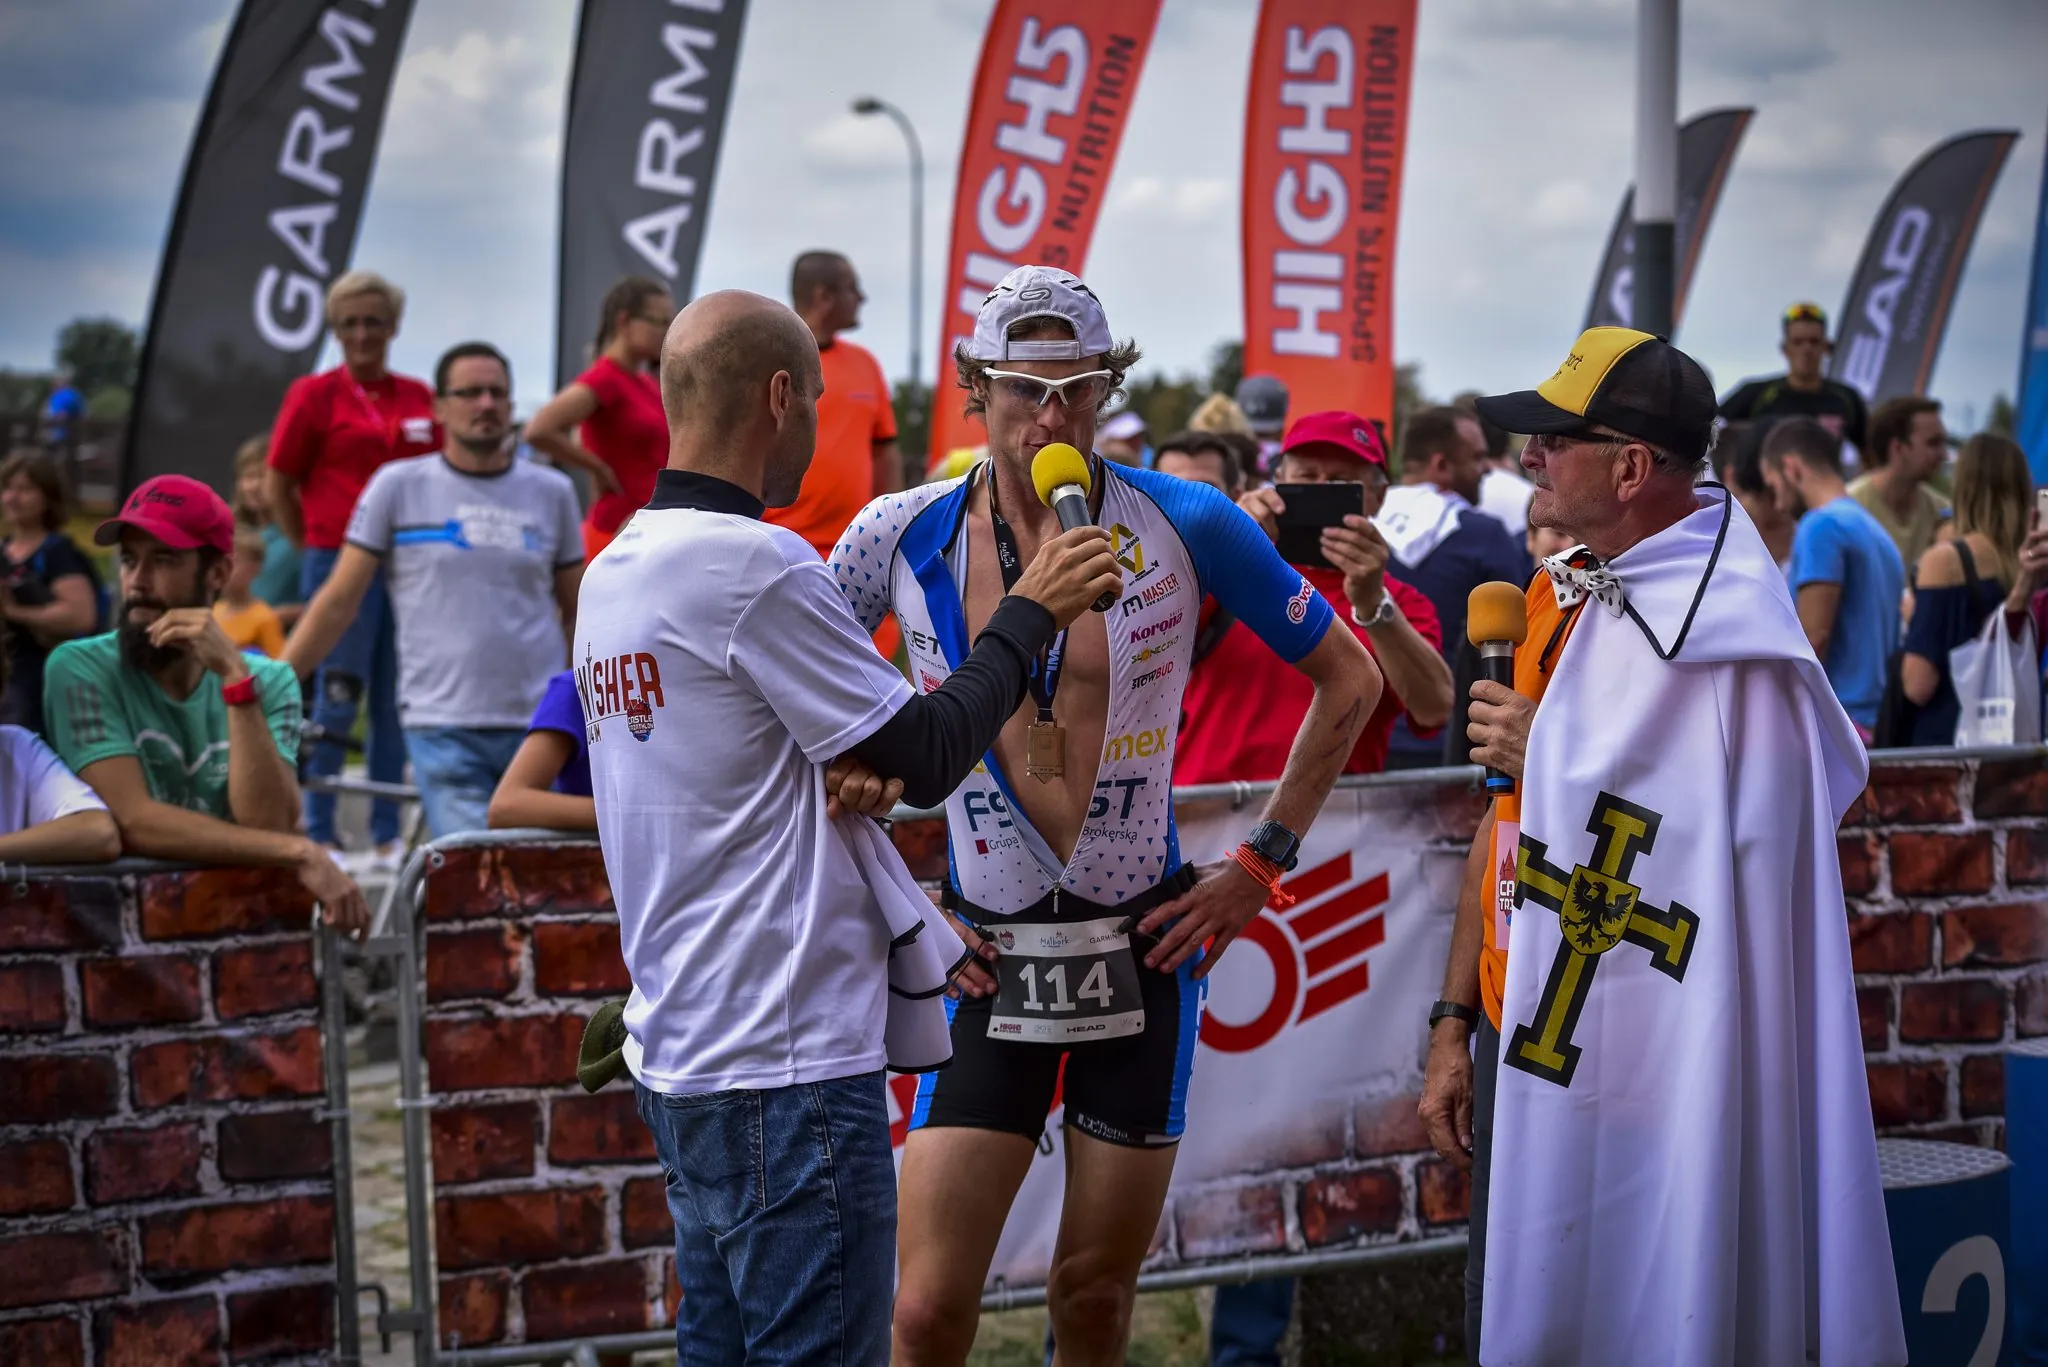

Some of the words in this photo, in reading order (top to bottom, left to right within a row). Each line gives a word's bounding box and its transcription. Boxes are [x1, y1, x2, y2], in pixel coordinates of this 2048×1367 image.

[252, 0, 386, 352] GARM
[1053, 33, 1138, 233] NUTRITION
[1361, 23, 1400, 214] NUTRITION
[1272, 25, 1355, 358] HIGH5
[1350, 226, 1385, 364] SPORTS
[1843, 206, 1931, 399] EAD
[1130, 612, 1183, 644] Korona
[1142, 572, 1179, 602] MASTER
[989, 836, 1019, 851] Grupa
[1082, 826, 1138, 841] Brokerska
[1018, 961, 1114, 1012] 114
[1040, 935, 1069, 946] Malbork
[1090, 933, 1118, 944] GARMIN
[1066, 1024, 1106, 1034] HEAD
[1921, 1234, 2006, 1367] 2
